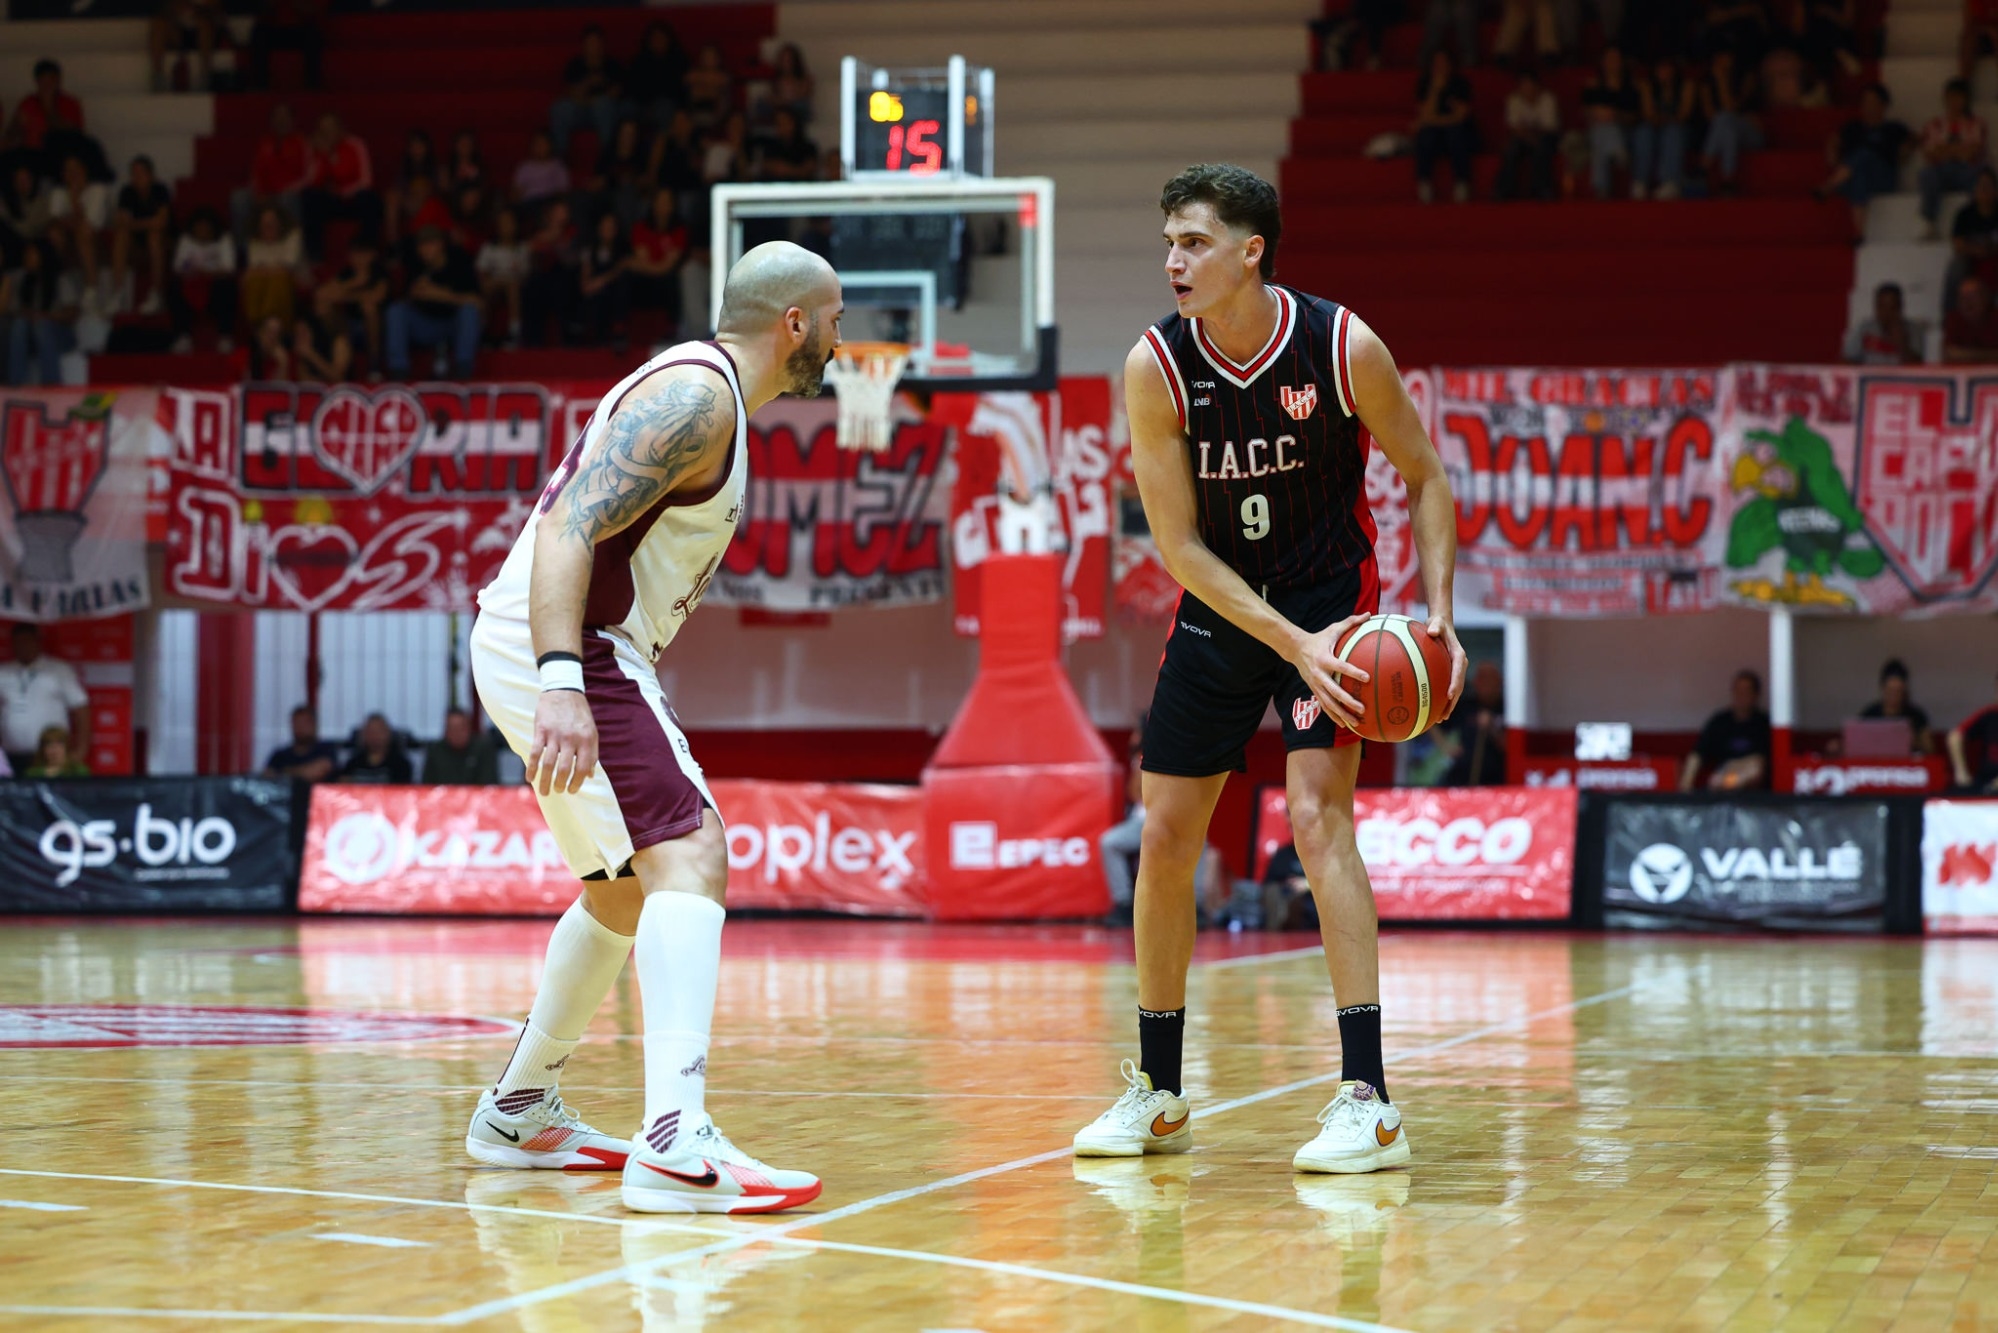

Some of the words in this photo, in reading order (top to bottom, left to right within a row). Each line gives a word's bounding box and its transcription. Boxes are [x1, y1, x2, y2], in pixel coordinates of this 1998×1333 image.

[886, 120, 942, 177] 15
[1198, 434, 1305, 479] I.A.C.C.
[1240, 493, 1271, 541] 9
